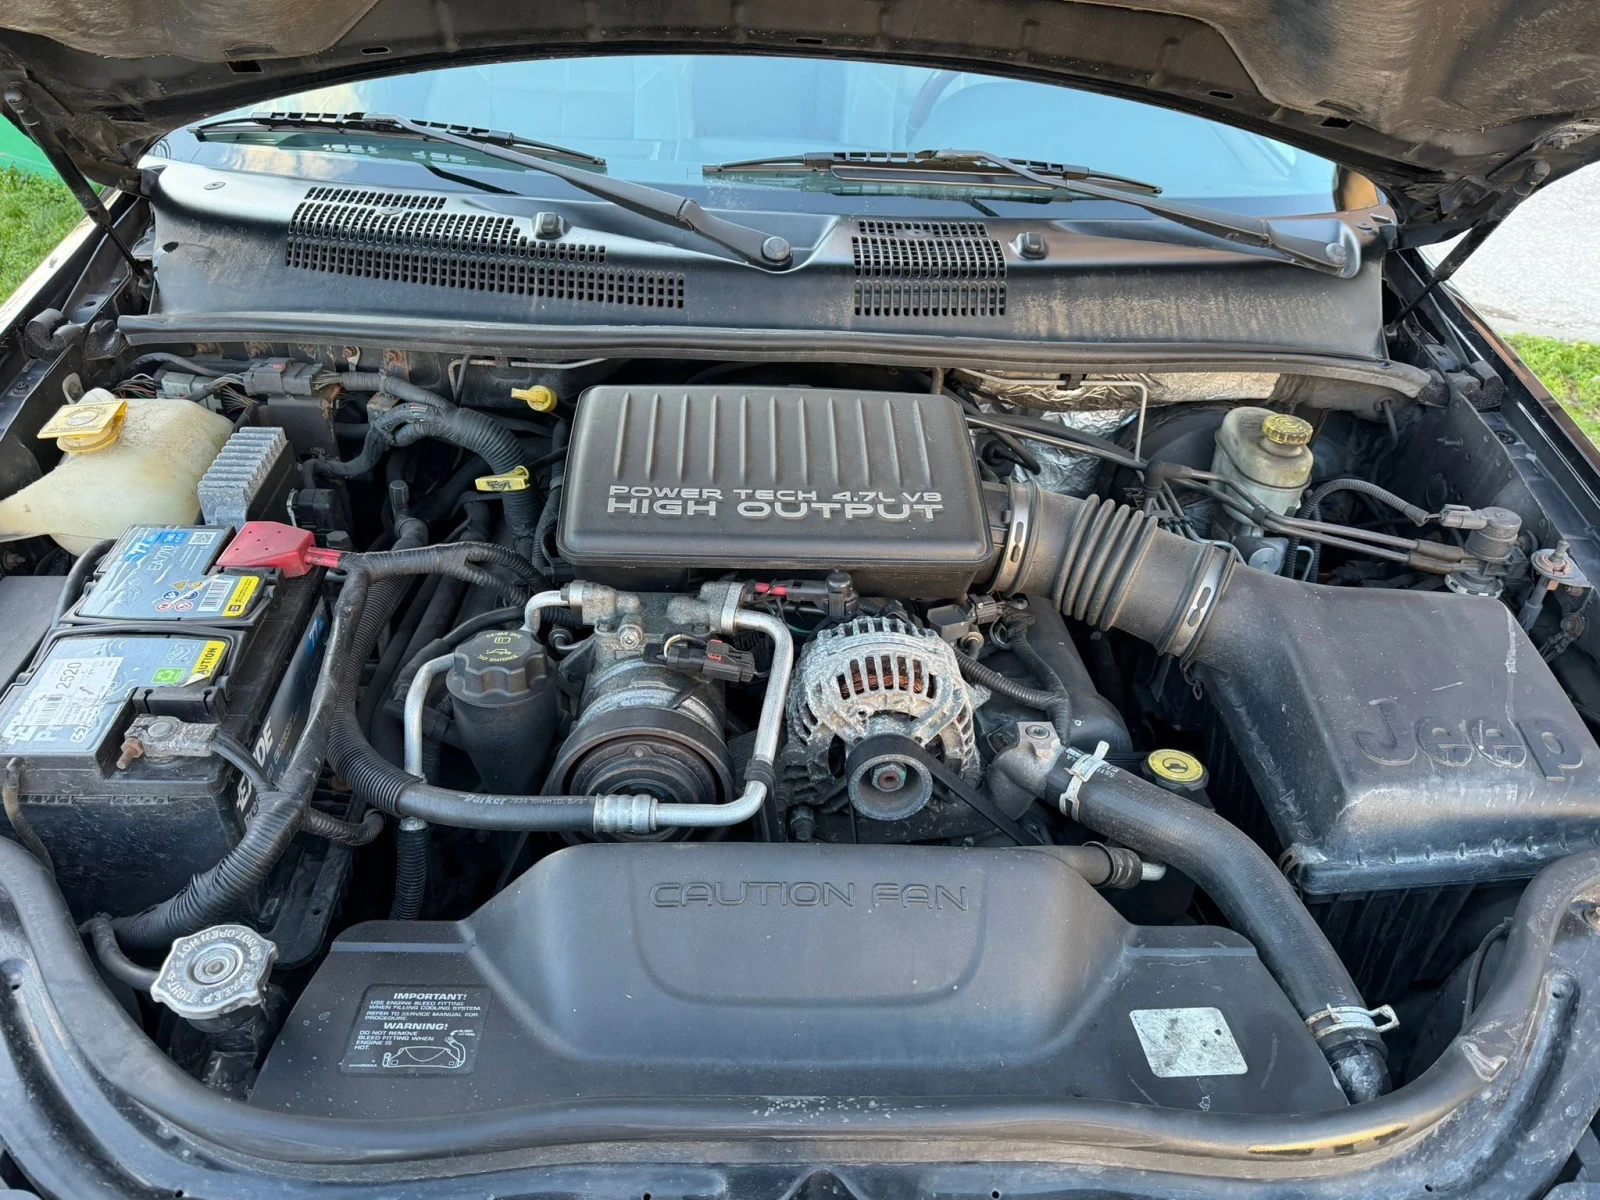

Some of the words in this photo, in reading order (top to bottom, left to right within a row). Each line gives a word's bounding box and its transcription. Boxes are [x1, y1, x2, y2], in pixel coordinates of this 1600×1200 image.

[609, 485, 724, 499] POWER
[733, 489, 817, 501] TECH
[832, 491, 895, 502] 4.7L
[902, 492, 942, 502] V8
[607, 497, 717, 516] HIGH
[736, 501, 943, 519] OUTPUT
[147, 545, 175, 571] EA770
[488, 654, 519, 663] ENGINE
[55, 661, 82, 690] 2520
[1353, 699, 1584, 781] Jeep
[462, 793, 508, 805] Parker
[650, 882, 854, 907] CAUTION
[871, 883, 968, 911] FAN
[200, 928, 236, 944] OPEN
[393, 992, 467, 1001] IMPORTANT!
[383, 1022, 448, 1031] WARNING!
